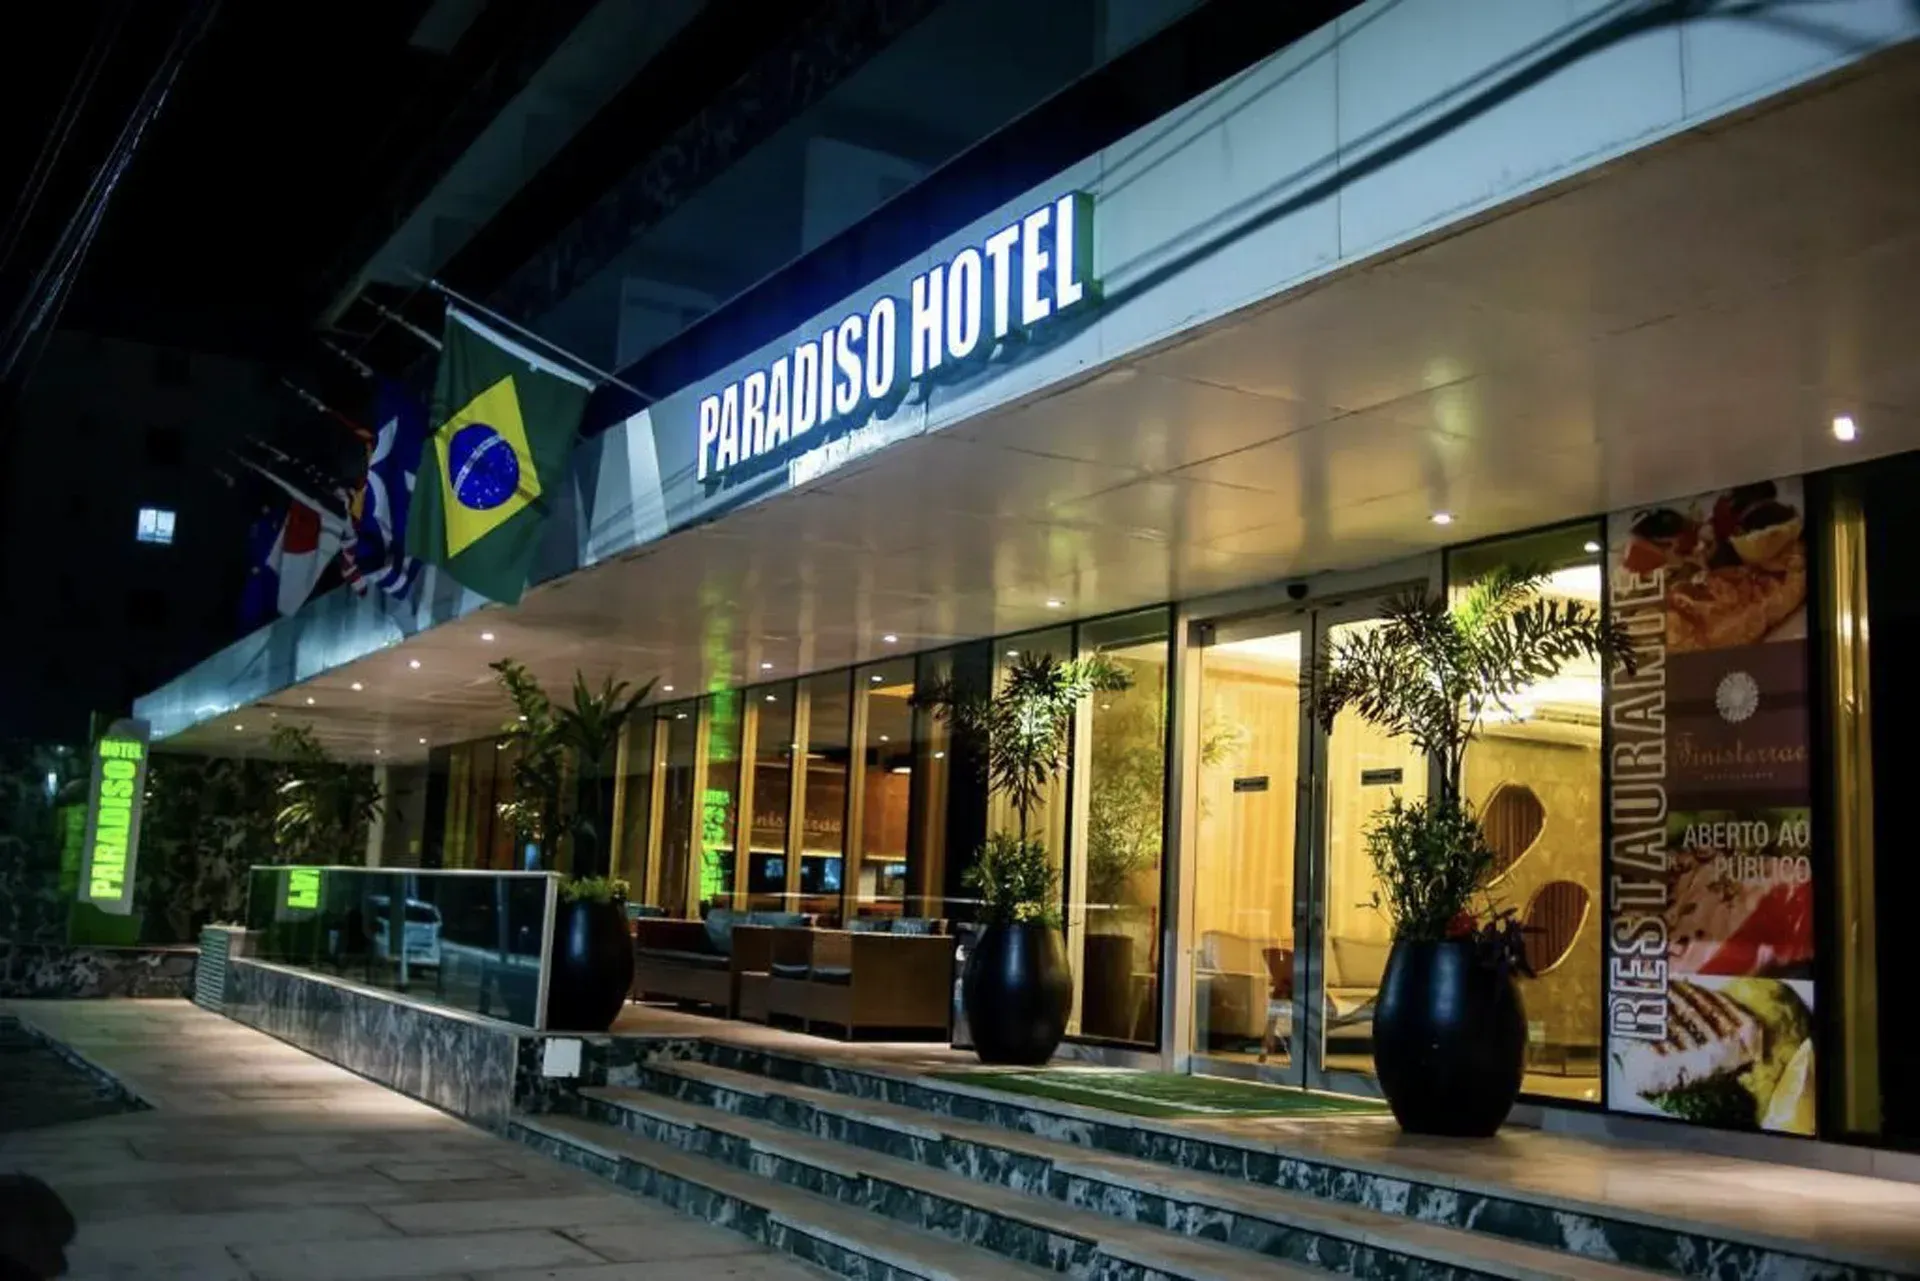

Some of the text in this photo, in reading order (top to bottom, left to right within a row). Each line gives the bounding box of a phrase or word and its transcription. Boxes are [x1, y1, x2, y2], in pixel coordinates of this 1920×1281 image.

[697, 194, 1083, 483] PARADISO HOTEL
[100, 739, 142, 760] HOTEL
[1609, 567, 1667, 1042] RESTAURANTE
[90, 759, 136, 899] PARADISO
[1682, 819, 1811, 850] ABERTO AO
